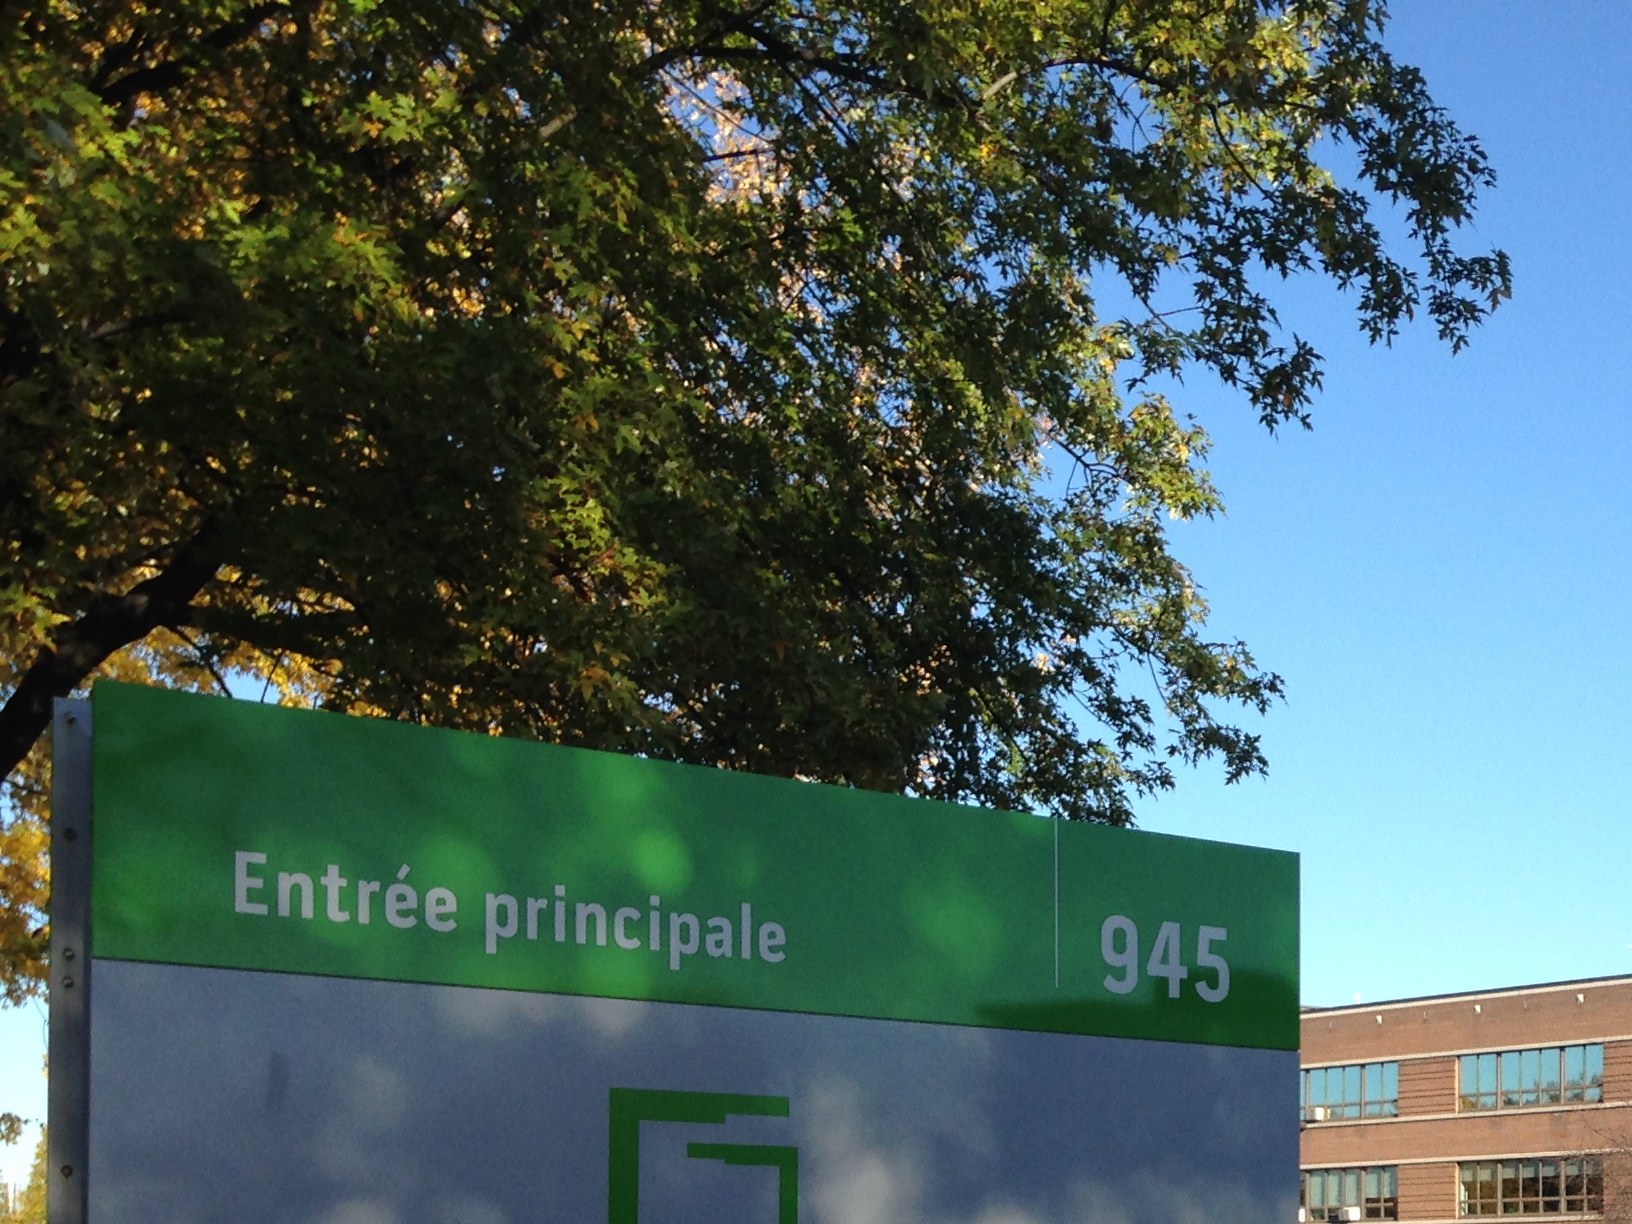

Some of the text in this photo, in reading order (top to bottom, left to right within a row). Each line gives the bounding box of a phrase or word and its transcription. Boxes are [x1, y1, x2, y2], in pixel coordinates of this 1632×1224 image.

[233, 850, 787, 970] Entrée principale
[1101, 914, 1231, 1003] 945
